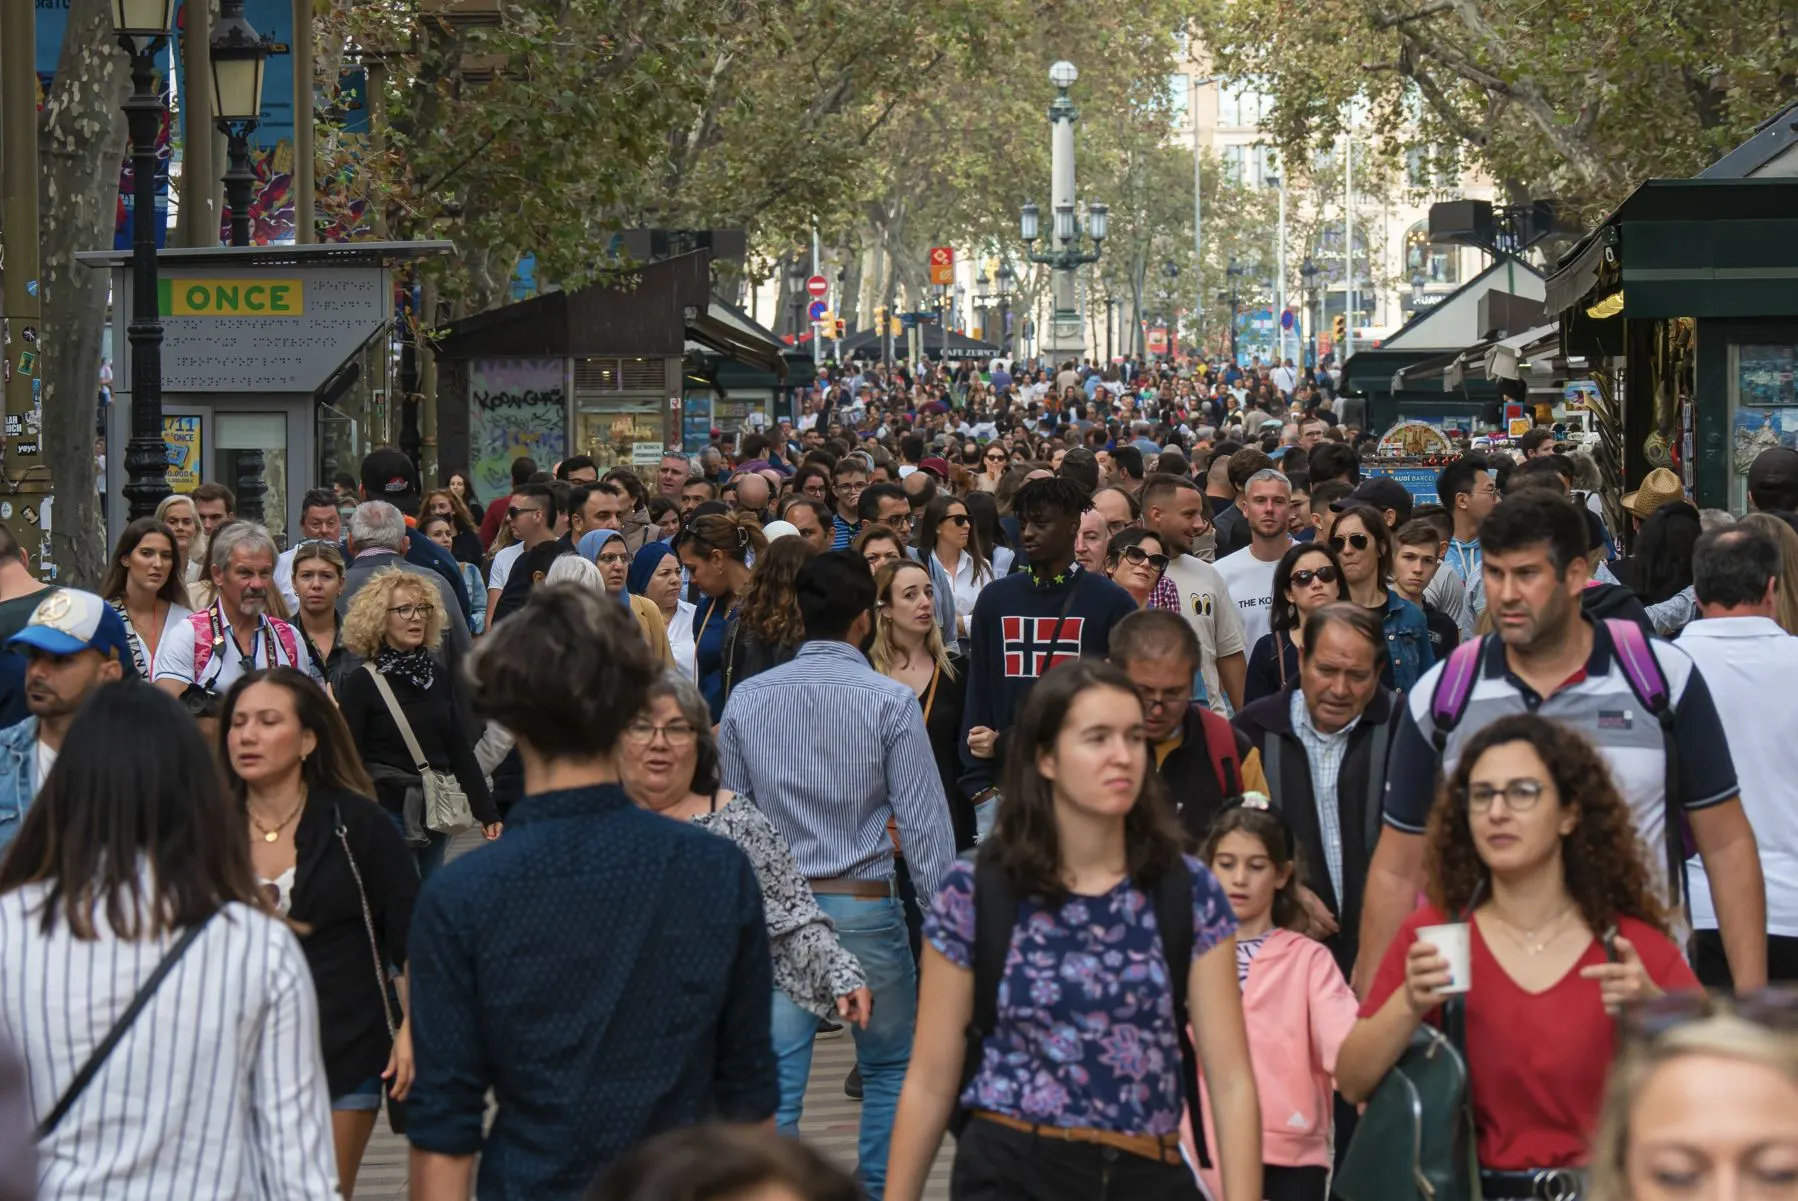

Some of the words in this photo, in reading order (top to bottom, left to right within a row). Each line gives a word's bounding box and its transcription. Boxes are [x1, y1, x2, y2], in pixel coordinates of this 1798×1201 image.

[186, 286, 290, 311] ONCE
[174, 433, 194, 442] ONCE
[18, 445, 37, 454] yeyo
[1238, 598, 1257, 609] THE
[1258, 596, 1273, 606] KO
